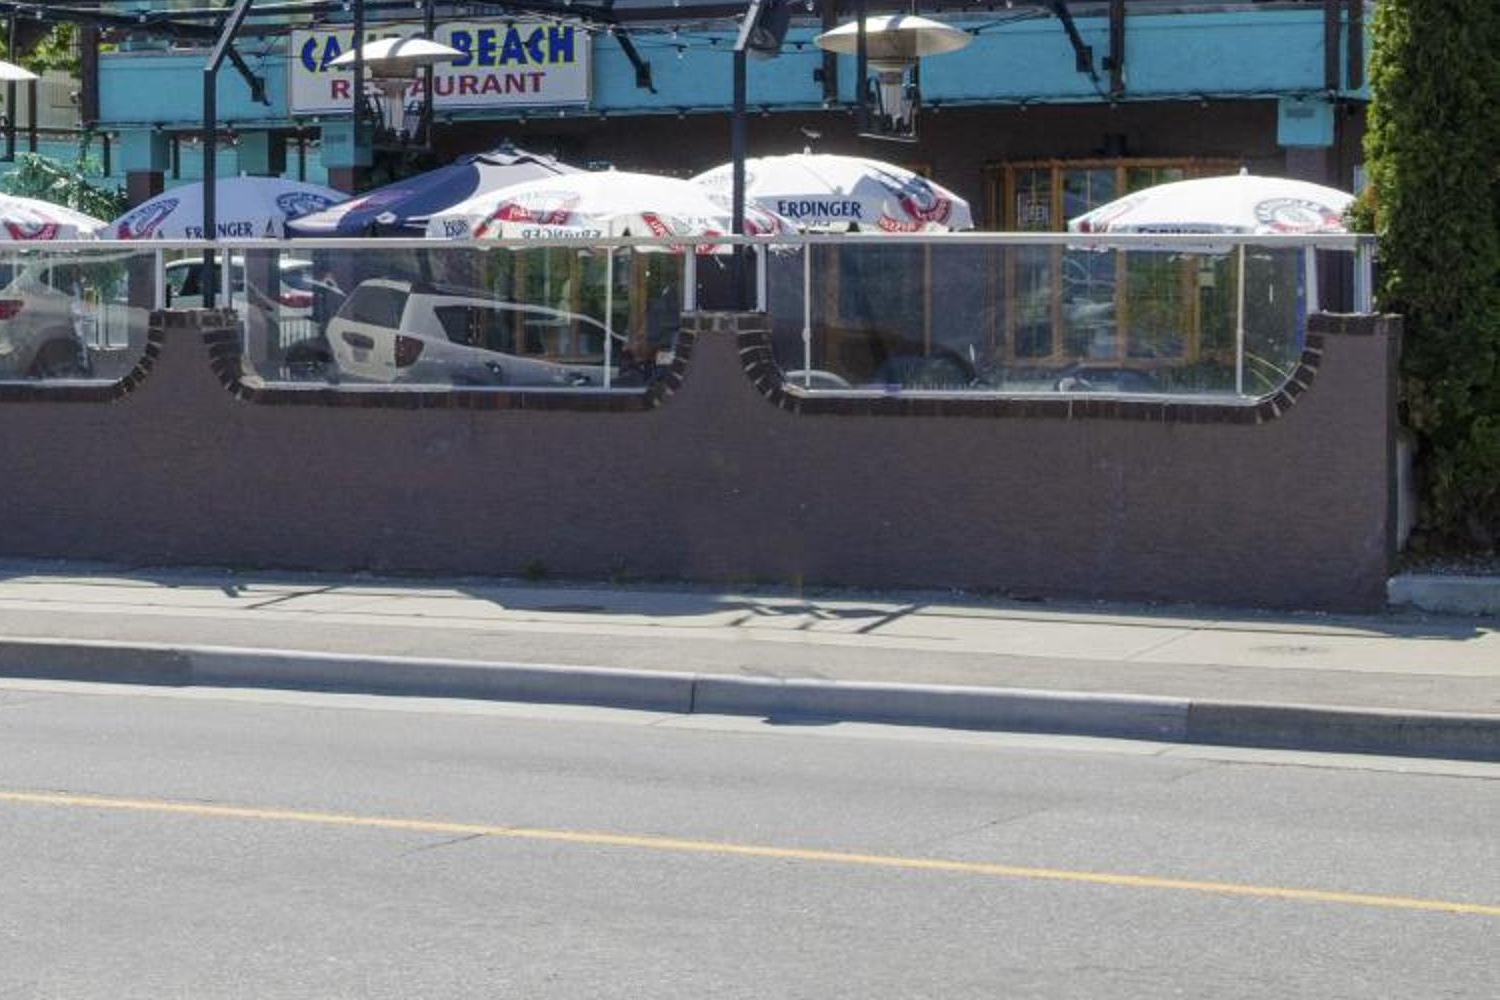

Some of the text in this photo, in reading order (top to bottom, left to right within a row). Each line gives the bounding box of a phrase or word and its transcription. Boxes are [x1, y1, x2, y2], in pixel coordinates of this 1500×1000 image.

[451, 26, 575, 67] BEACH
[331, 71, 546, 100] RAURANT
[778, 200, 863, 218] ERDINGER
[185, 221, 253, 239] ERNGER
